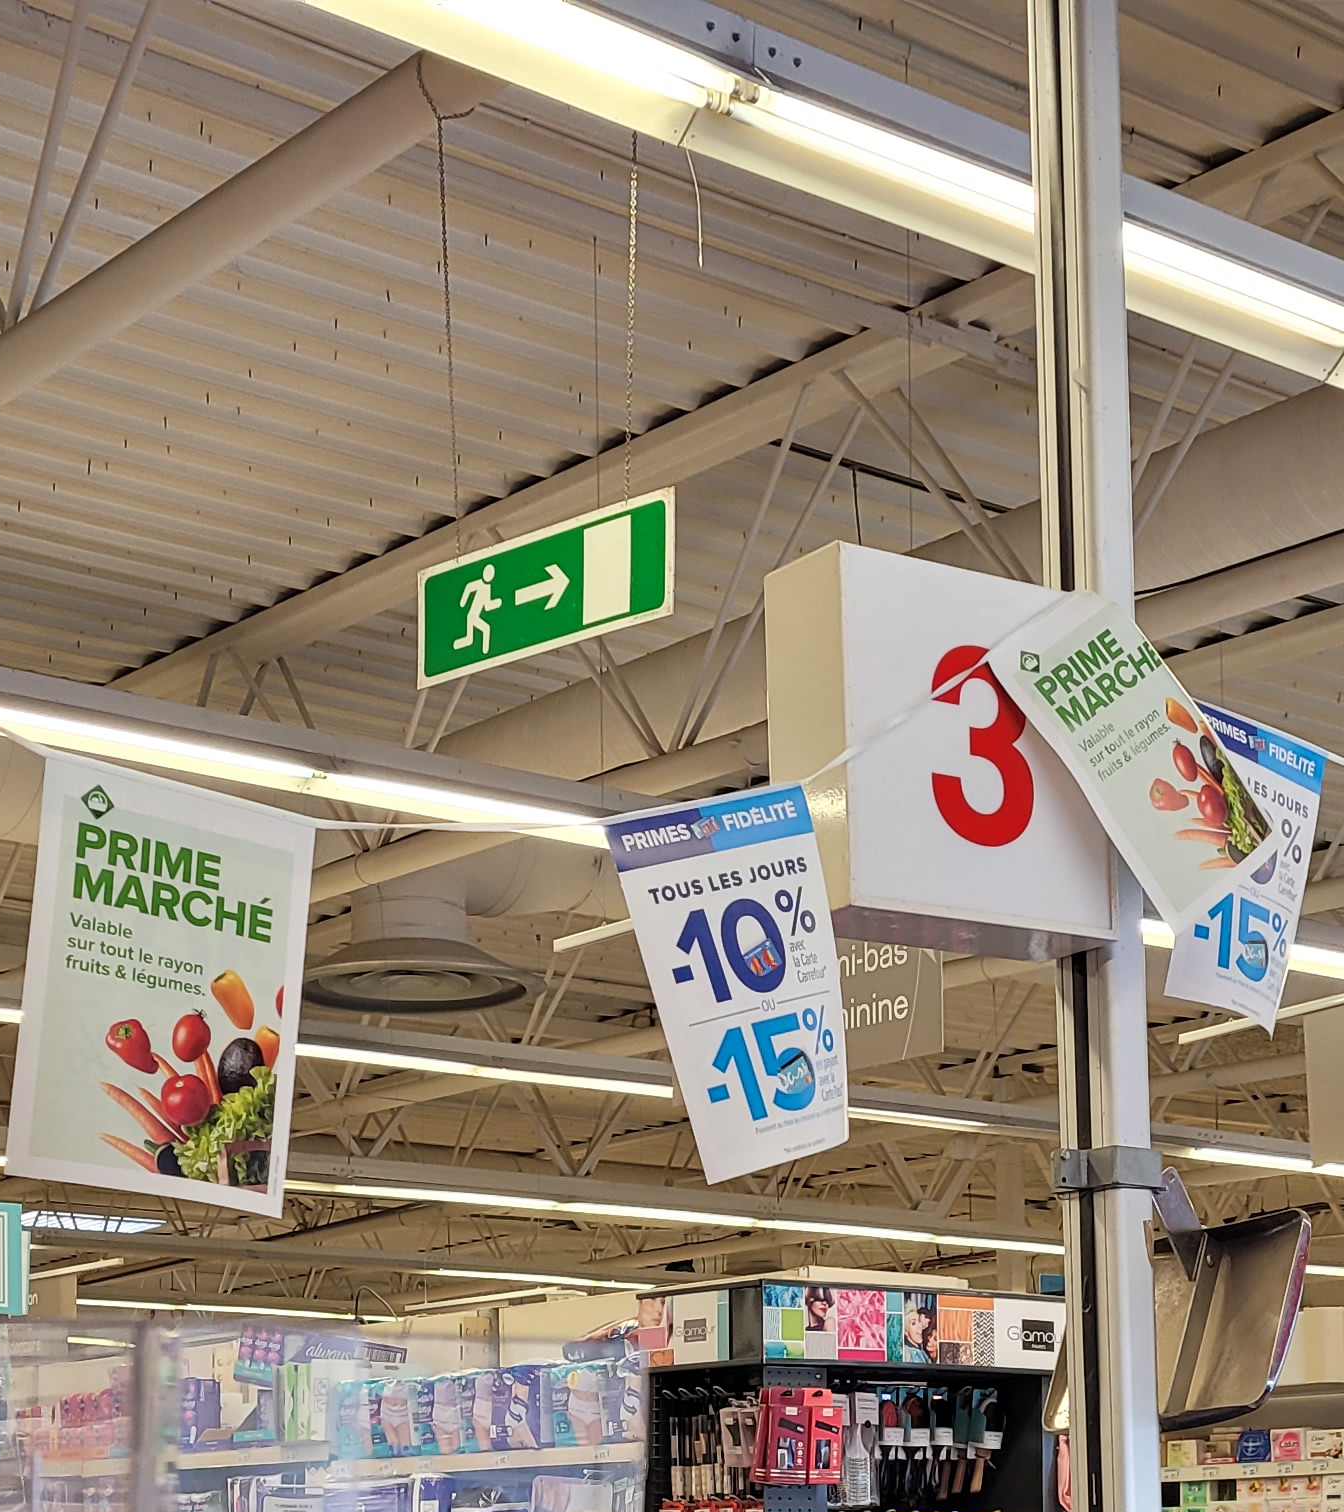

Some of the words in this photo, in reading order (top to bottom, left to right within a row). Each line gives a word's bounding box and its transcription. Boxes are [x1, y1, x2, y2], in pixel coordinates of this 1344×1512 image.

[1034, 628, 1125, 706] PRIME
[932, 646, 1034, 847] 3
[1078, 721, 1114, 752] Valable
[621, 823, 691, 852] PRIMES
[722, 800, 798, 832] FIDÉLITÉ
[75, 821, 222, 891] PRIME
[648, 879, 704, 904] TOUS
[708, 866, 743, 891] LES
[749, 856, 807, 883] JOURS
[69, 912, 133, 939] Valable
[72, 862, 273, 943] MARCHÉ
[65, 954, 110, 977] fruits
[114, 962, 127, 980] &
[131, 966, 206, 999] légumes.
[67, 936, 95, 953] sur
[99, 940, 134, 961] tout
[138, 947, 153, 965] le
[157, 953, 204, 977] rayon
[761, 998, 776, 1013] OU
